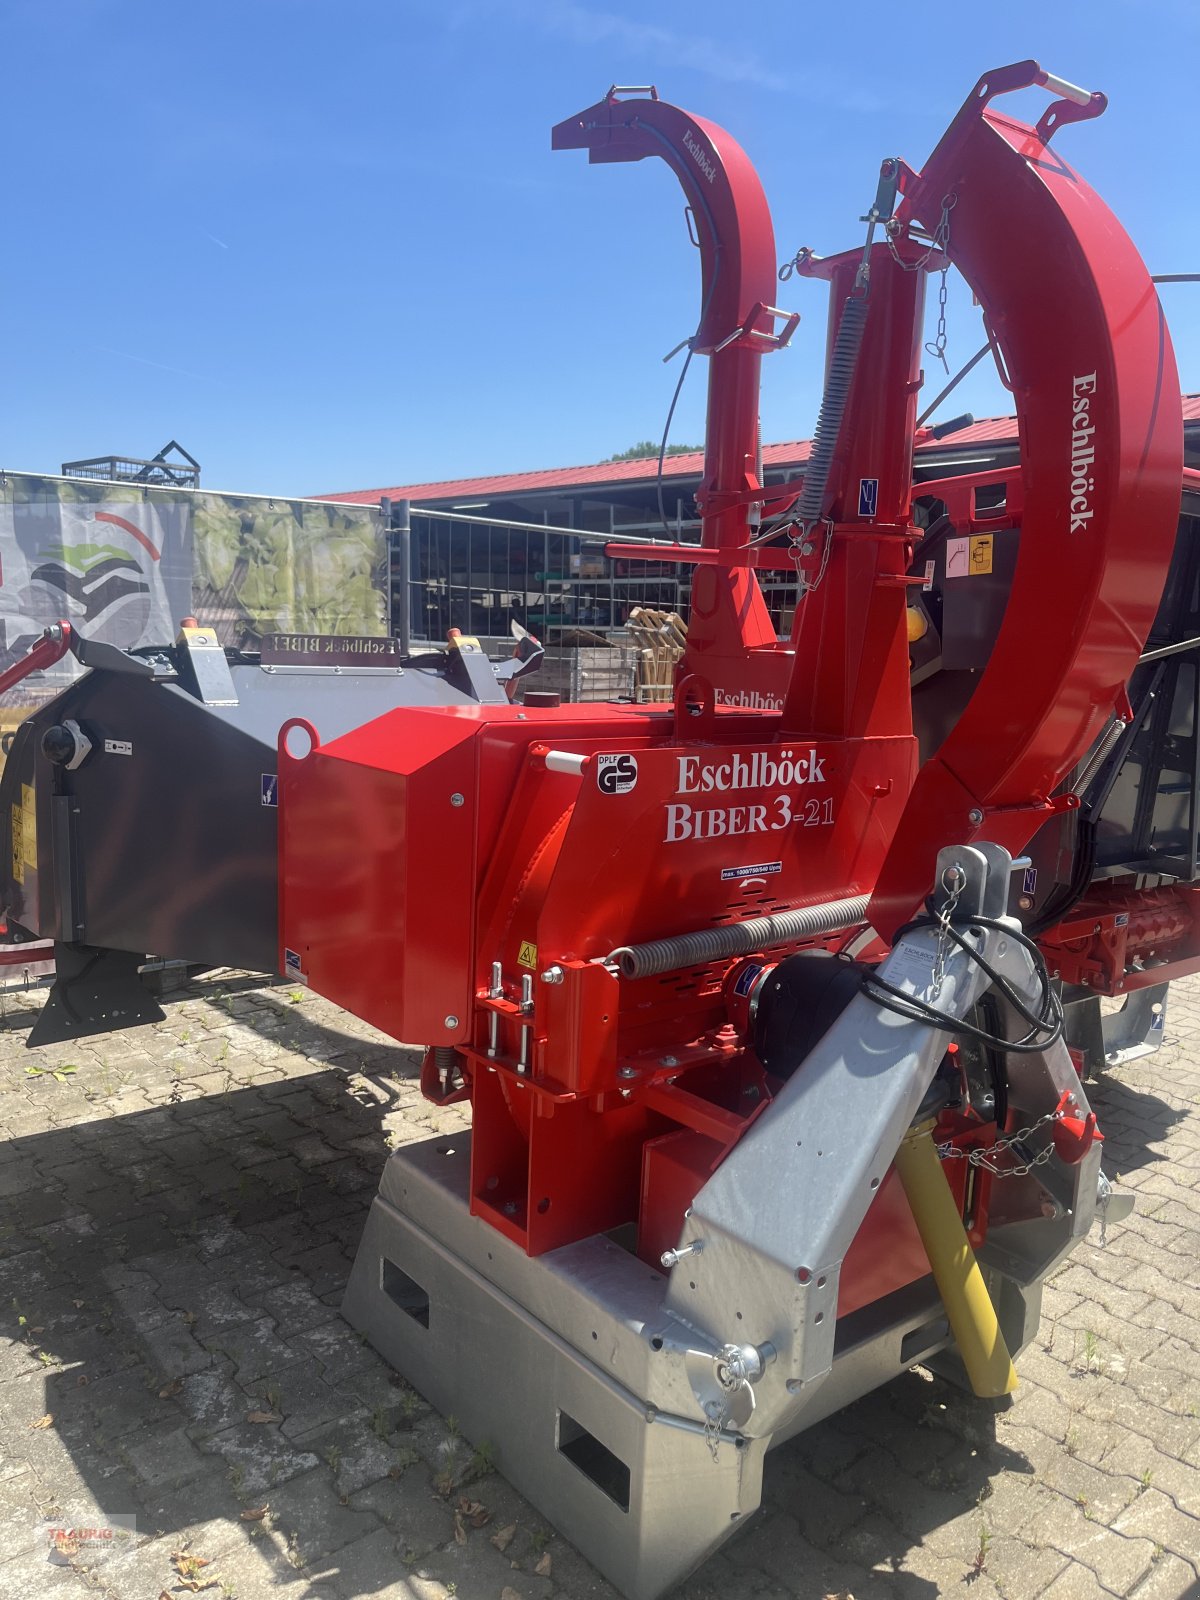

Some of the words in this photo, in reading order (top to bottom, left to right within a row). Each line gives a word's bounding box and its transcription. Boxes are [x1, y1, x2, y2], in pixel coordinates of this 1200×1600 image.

[683, 129, 717, 184] Eschlböck
[1070, 370, 1097, 533] Eschlböck
[713, 688, 787, 710] Eschlböc
[598, 755, 637, 793] GS
[599, 756, 617, 764] DPLF
[675, 750, 827, 794] Eschlböck
